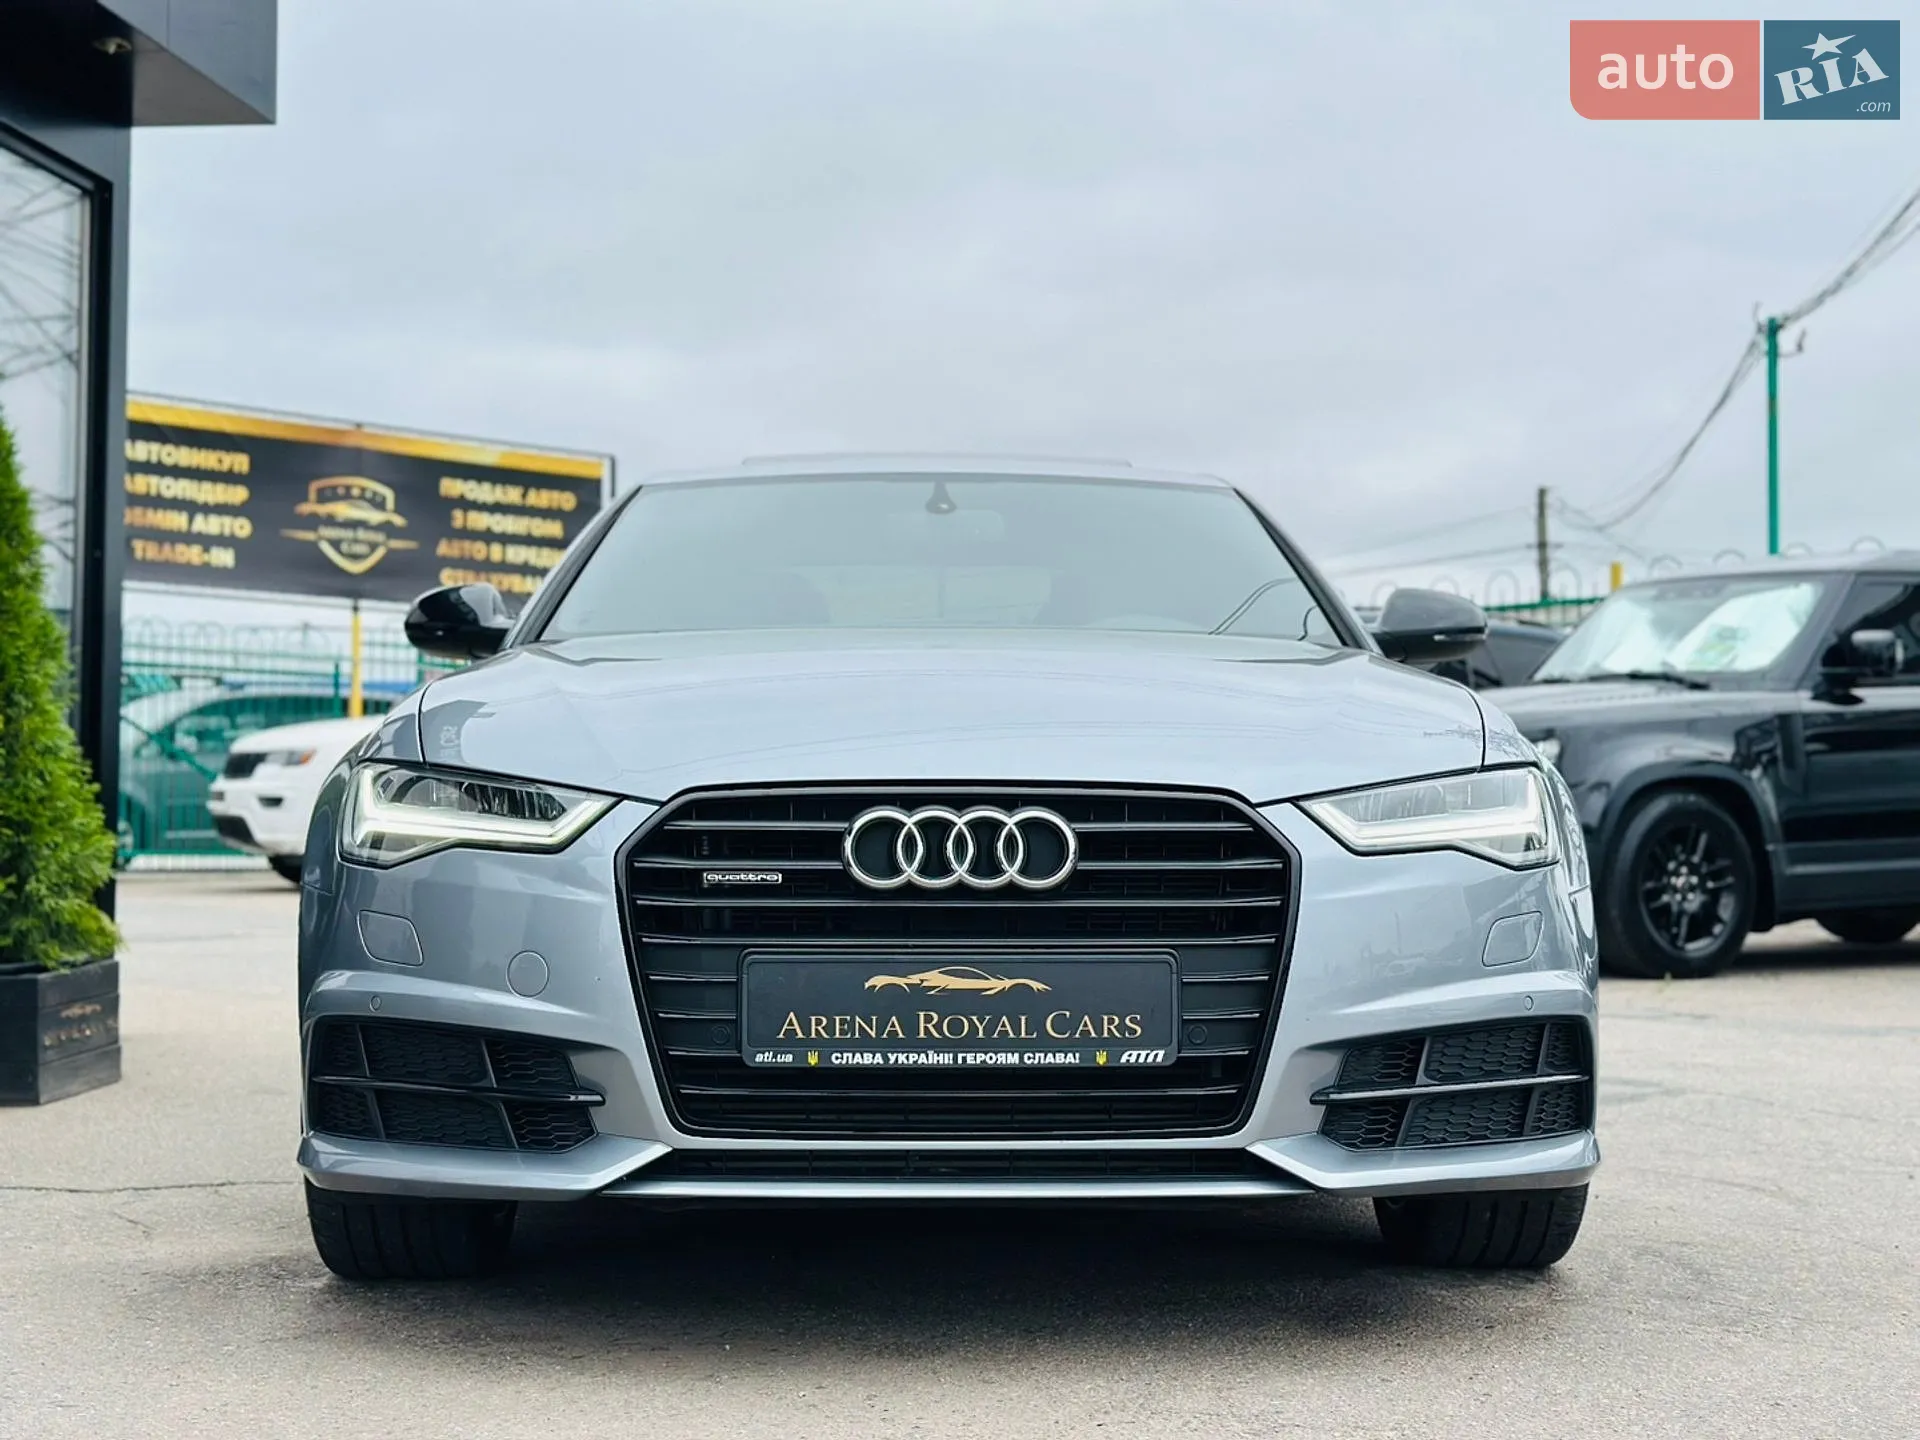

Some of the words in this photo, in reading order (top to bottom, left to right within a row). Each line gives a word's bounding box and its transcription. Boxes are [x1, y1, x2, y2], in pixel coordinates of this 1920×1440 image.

[439, 477, 524, 505] ПРОДАЖ
[525, 488, 577, 512] АВТО
[190, 512, 252, 538] АВТО
[131, 539, 236, 569] TRADE-IN
[436, 538, 488, 561] АВТО
[489, 542, 503, 563] В
[705, 872, 780, 883] quattro
[776, 1010, 907, 1039] ARENA
[915, 1010, 1037, 1039] ROYAL
[1045, 1010, 1142, 1039] CARS
[754, 1051, 794, 1063] atl.ua
[831, 1052, 884, 1064] СЛАВА
[888, 1050, 954, 1064] УКРАЇНІ!
[957, 1052, 1020, 1064] ГЕРОЯМ
[1023, 1052, 1080, 1064] СЛАВА!
